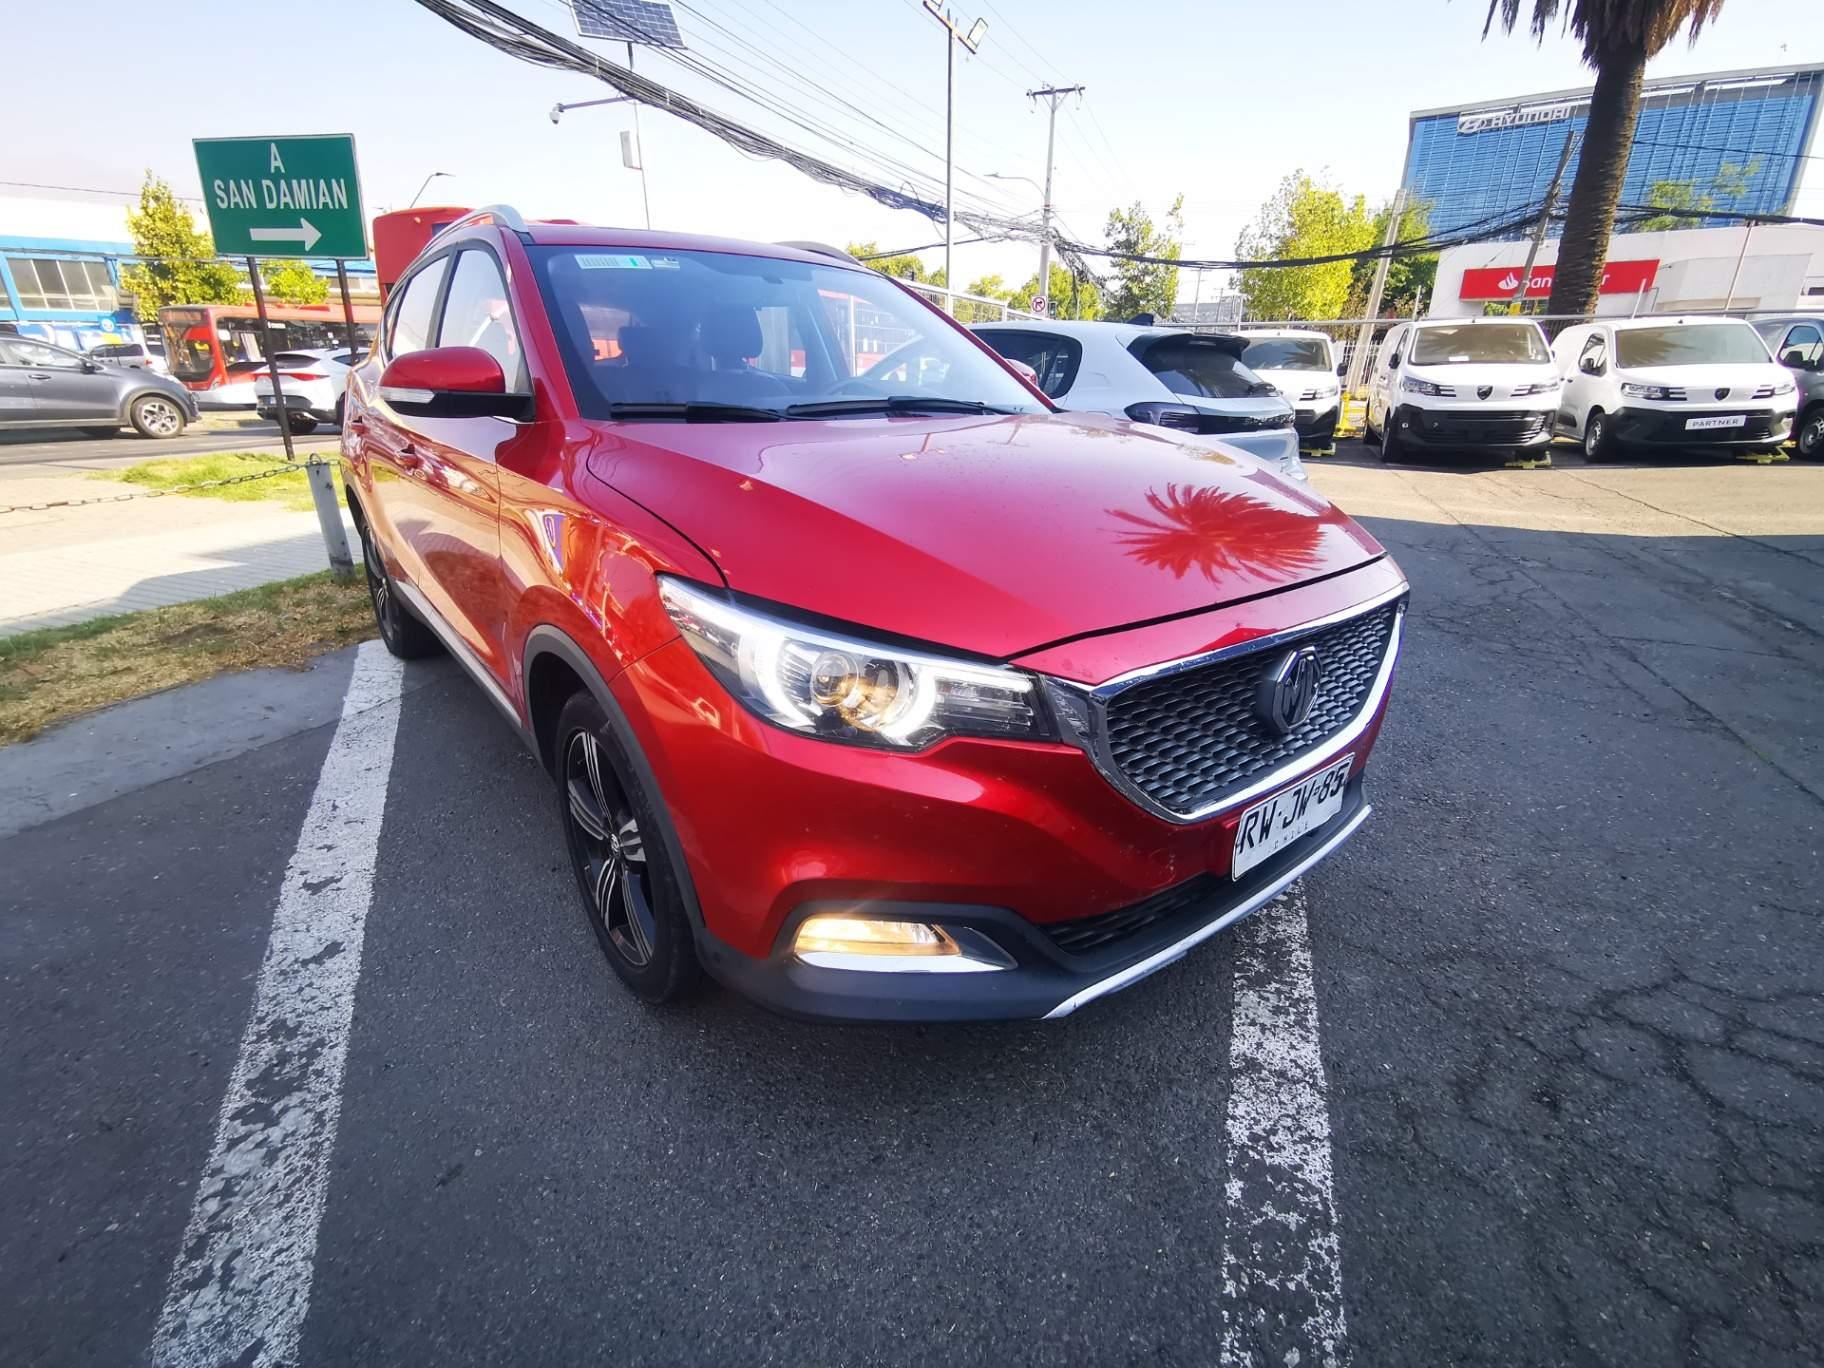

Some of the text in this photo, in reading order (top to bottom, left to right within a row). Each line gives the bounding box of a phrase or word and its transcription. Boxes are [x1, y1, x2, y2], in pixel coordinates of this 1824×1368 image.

[1490, 105, 1571, 129] HYUNDAI
[270, 142, 286, 174] A
[213, 178, 348, 209] SAN DAMIAN
[1692, 418, 1738, 427] PARTNER
